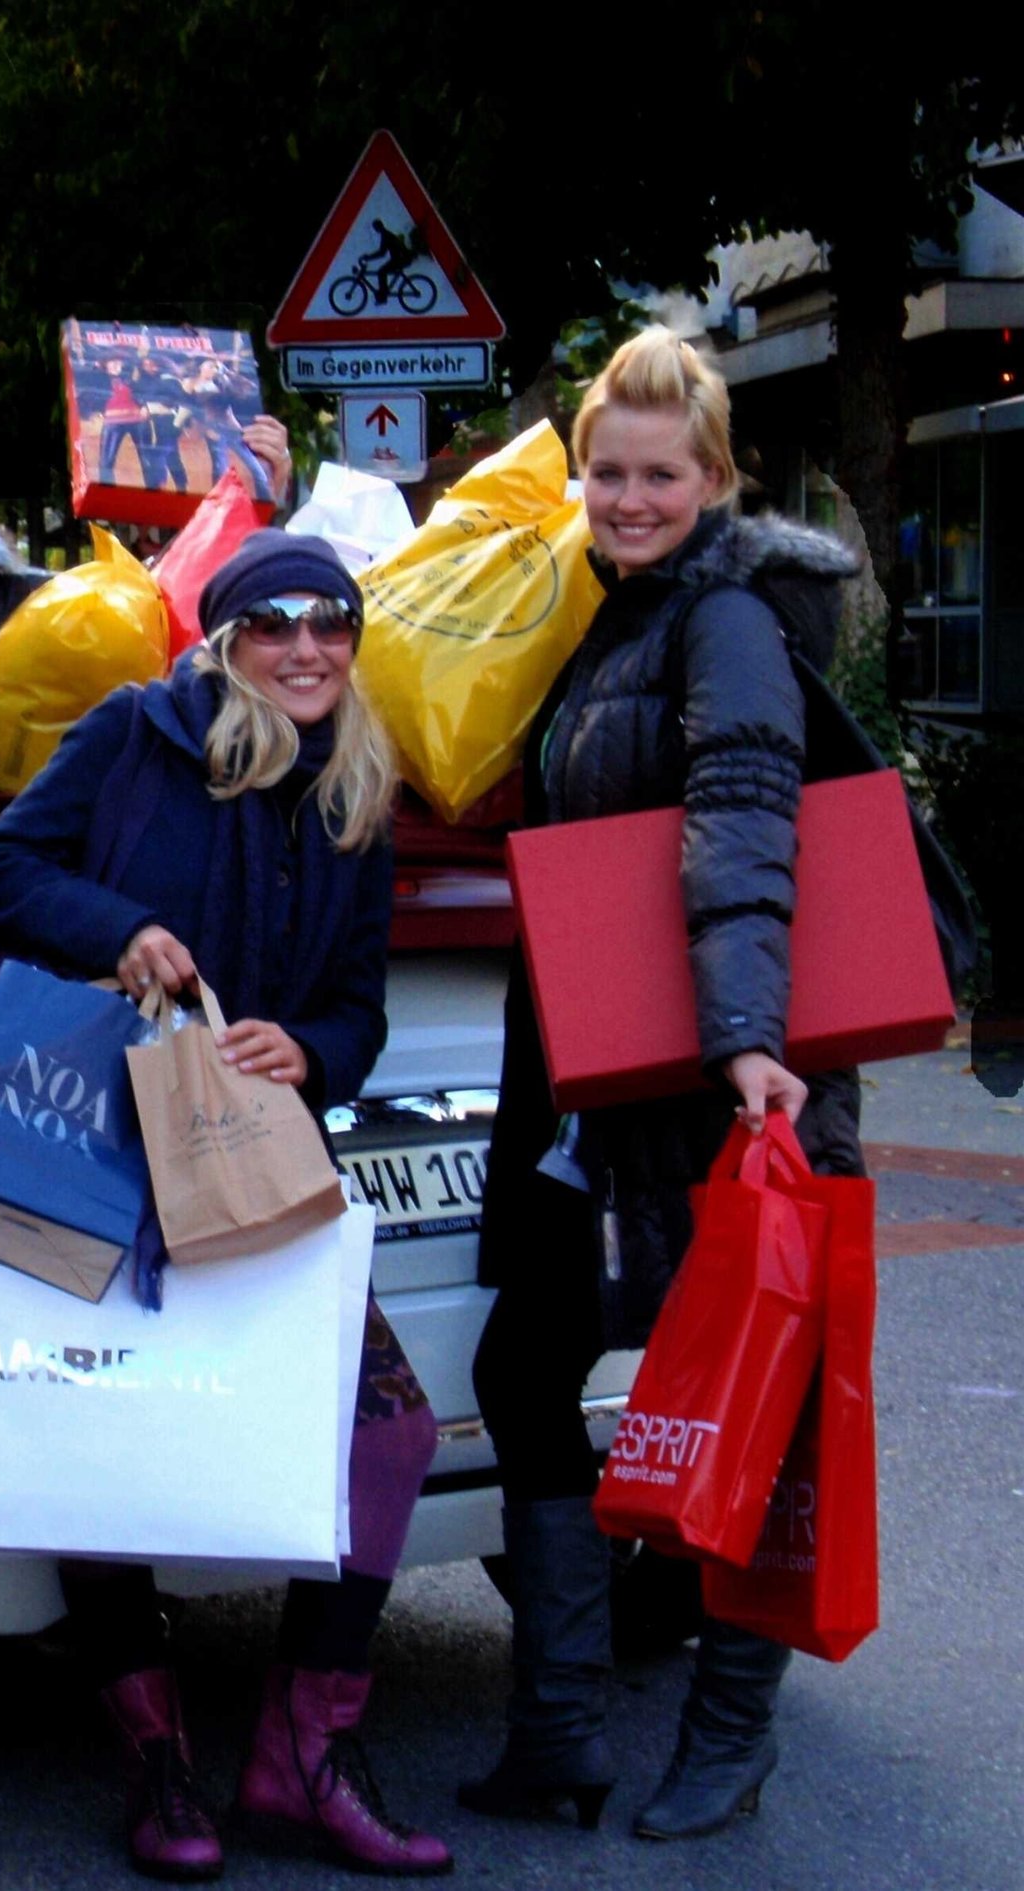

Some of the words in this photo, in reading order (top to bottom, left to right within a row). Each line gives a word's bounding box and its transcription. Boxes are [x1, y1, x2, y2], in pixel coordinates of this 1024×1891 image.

[296, 356, 314, 377] Im
[322, 354, 466, 379] Gegenverkehr
[10, 1042, 108, 1134] NOA
[426, 1147, 491, 1209] 10
[609, 1411, 721, 1468] ESPRIT
[612, 1463, 677, 1486] esprit.com
